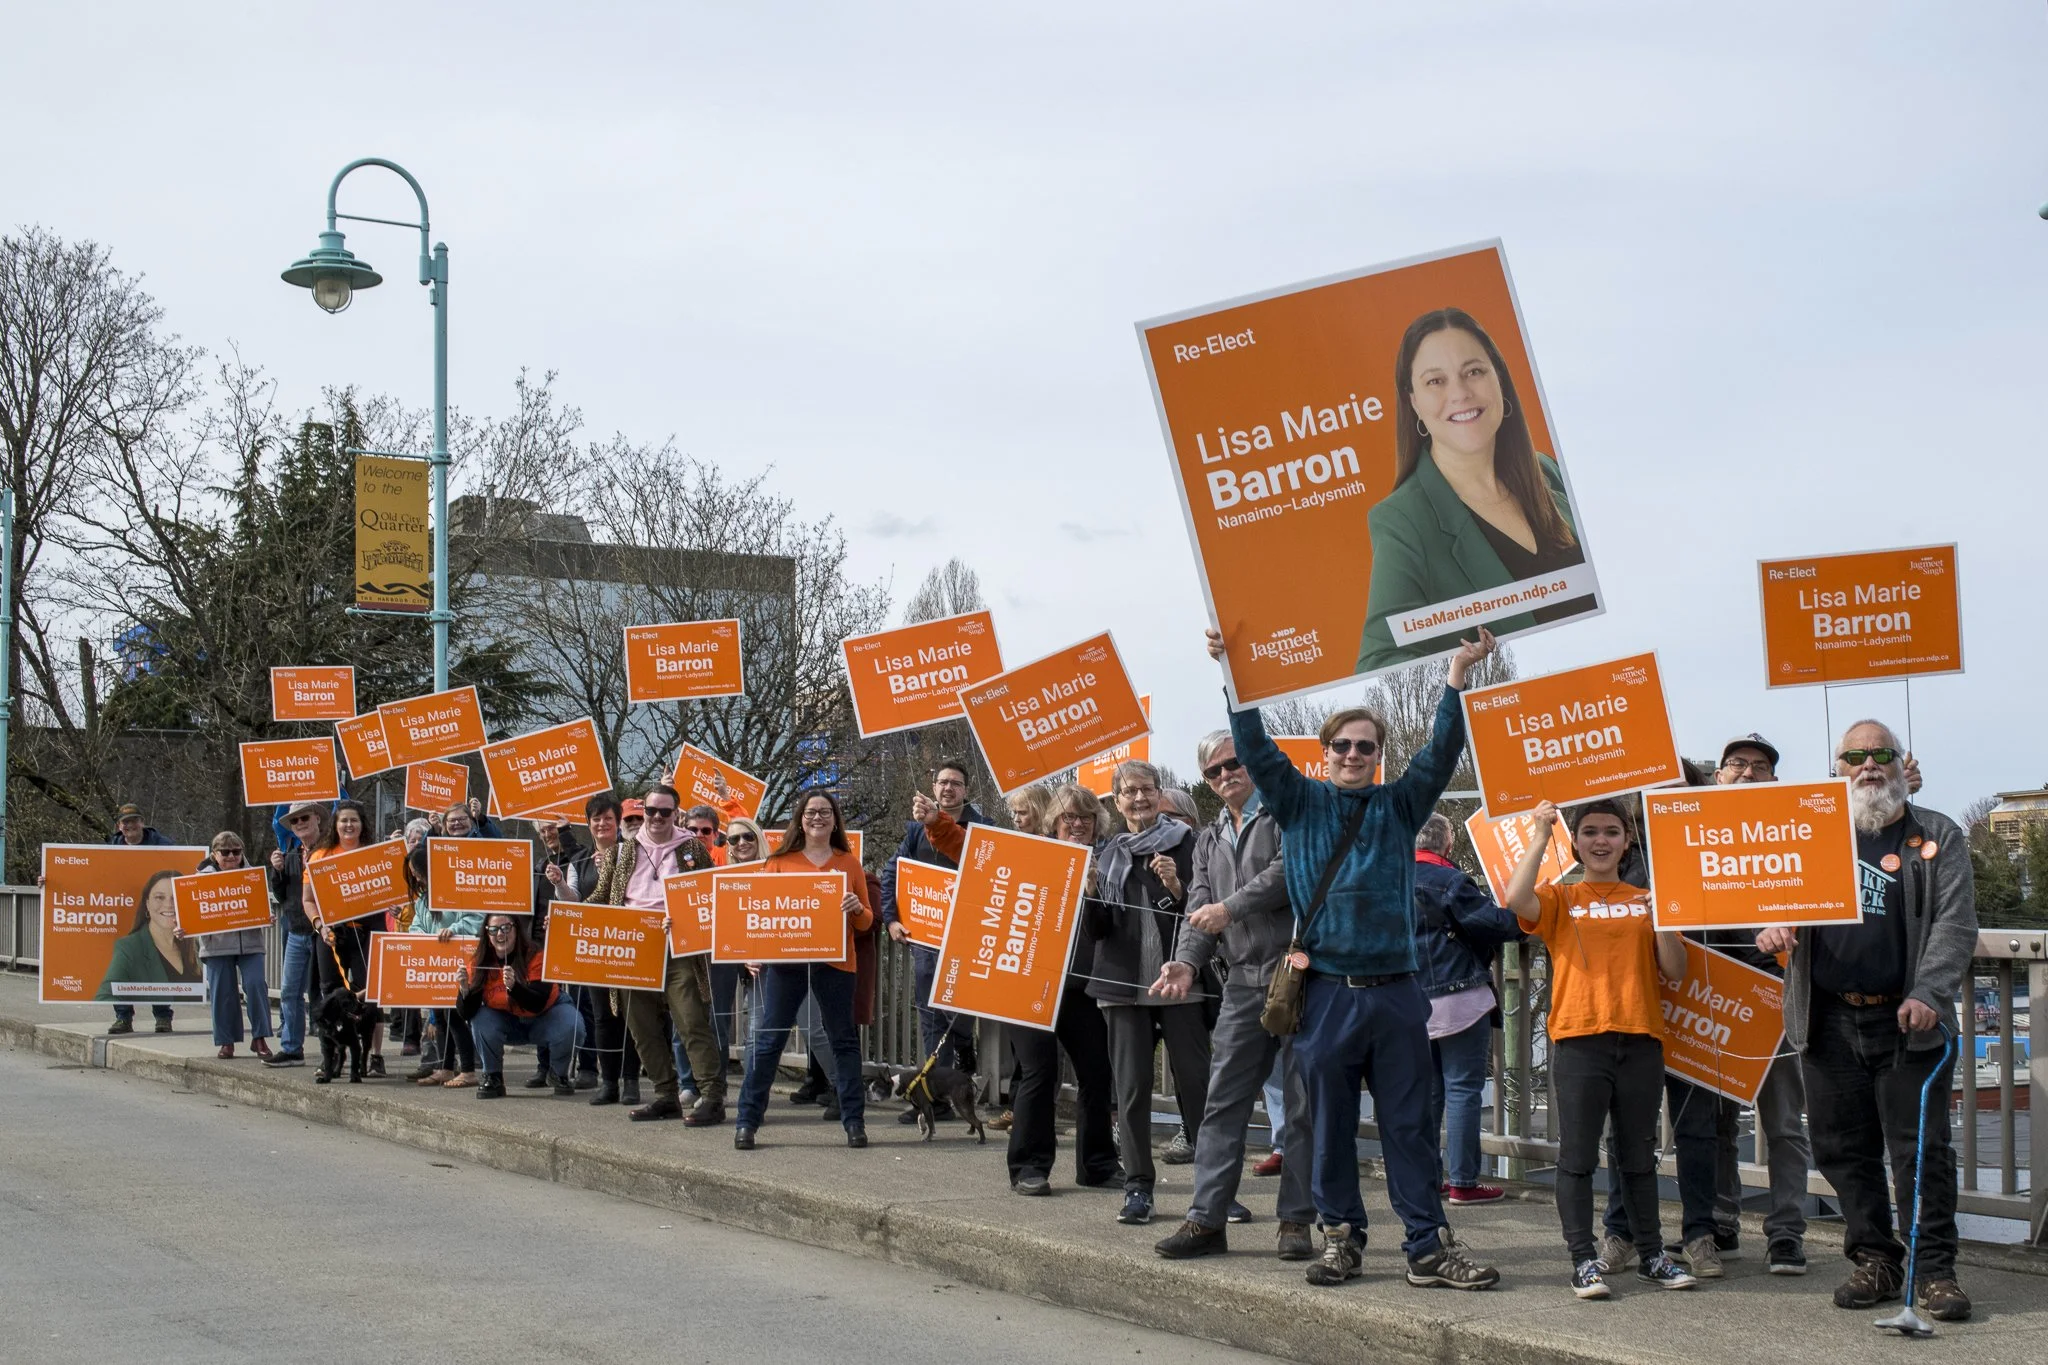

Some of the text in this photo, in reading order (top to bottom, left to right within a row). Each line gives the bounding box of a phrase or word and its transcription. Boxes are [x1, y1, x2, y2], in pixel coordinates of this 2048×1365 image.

[1174, 328, 1256, 363] Re-Elect
[1197, 393, 1383, 465] Lisa Marie
[363, 464, 422, 482] Welcome
[1206, 446, 1360, 511] Barron
[364, 483, 402, 495] to the
[360, 509, 425, 533] Quarter
[381, 512, 421, 525] Old City
[1769, 567, 1816, 580] Re-Elect
[1910, 560, 1943, 571] Jagmeet
[1922, 567, 1943, 575] Singh
[1799, 581, 1921, 610] Lisa Marie
[1403, 579, 1567, 633] LisaMarieBarron.ndp.ca
[1277, 627, 1295, 637] NDP
[1814, 612, 1911, 638] Barron
[648, 641, 719, 656] Lisa Marie
[853, 641, 881, 653] Re-Elect
[1250, 629, 1320, 661] Jagmeet
[874, 641, 971, 674] Lisa Marie
[1280, 644, 1324, 666] Singh
[1869, 654, 1949, 667] LisaMarieBarron.ndp.ca
[656, 658, 713, 673] Barron
[888, 665, 968, 695] Barron
[1612, 667, 1646, 683] Jagmeet
[1626, 675, 1648, 686] Singh
[288, 680, 339, 689] Lisa Marie
[294, 691, 335, 701] Barron
[971, 684, 1009, 706] Re-Elect
[999, 673, 1097, 723] Lisa Marie
[1473, 693, 1520, 712] Re-Elect
[400, 707, 461, 728] Lisa Marie
[1017, 697, 1098, 742] Barron
[1505, 694, 1628, 737] Lisa Marie
[357, 728, 380, 742] Lisa
[410, 722, 458, 740] Barron
[1523, 725, 1622, 763] Barron
[489, 747, 516, 758] Re-Elect
[508, 744, 578, 771] Lisa Marie
[259, 755, 319, 768] Lisa Marie
[267, 770, 315, 783] Barron
[418, 769, 432, 780] Lisa
[435, 773, 456, 785] Marie
[519, 761, 576, 785] Barron
[1585, 764, 1666, 786] LisaMarieBarron.ndp.ca
[421, 781, 451, 796] Barron
[726, 785, 745, 800] arie
[1653, 801, 1700, 814] Re-Elect
[1799, 797, 1835, 809] Jagmeet
[1813, 804, 1836, 814] Singh
[1685, 819, 1812, 847] Lisa Marie
[434, 844, 459, 852] Re-Elect
[55, 856, 89, 865] Re-Elect
[448, 857, 512, 870] Lisa Marie
[1700, 852, 1802, 877] Barron
[330, 860, 392, 885] Lisa Marie
[455, 872, 506, 886] Barron
[191, 884, 251, 901] Lisa Marie
[340, 874, 391, 897] Barron
[668, 880, 697, 890] Re-Elect
[720, 882, 751, 890] Re-Elect
[907, 882, 947, 903] Lisa Marie
[53, 892, 134, 907] Lisa Marie
[200, 898, 247, 914] Barron
[738, 896, 820, 911] Lisa Marie
[1758, 902, 1844, 912] LisaMarieBarron.ndp.ca
[53, 909, 117, 925] Barron
[554, 908, 582, 918] Re-Elect
[911, 898, 943, 921] Barron
[1589, 901, 1647, 919] NDP
[746, 914, 811, 930] Barron
[970, 866, 1011, 980] Lisa Marie
[996, 882, 1036, 974] Barron
[570, 924, 645, 941] Lisa Marie
[576, 939, 635, 959] Barron
[400, 956, 464, 966] Lisa Marie
[406, 969, 457, 982] Barron
[942, 957, 959, 1003] Re-Elect
[1688, 979, 1754, 1023] Marie
[1660, 1000, 1731, 1046] arron
